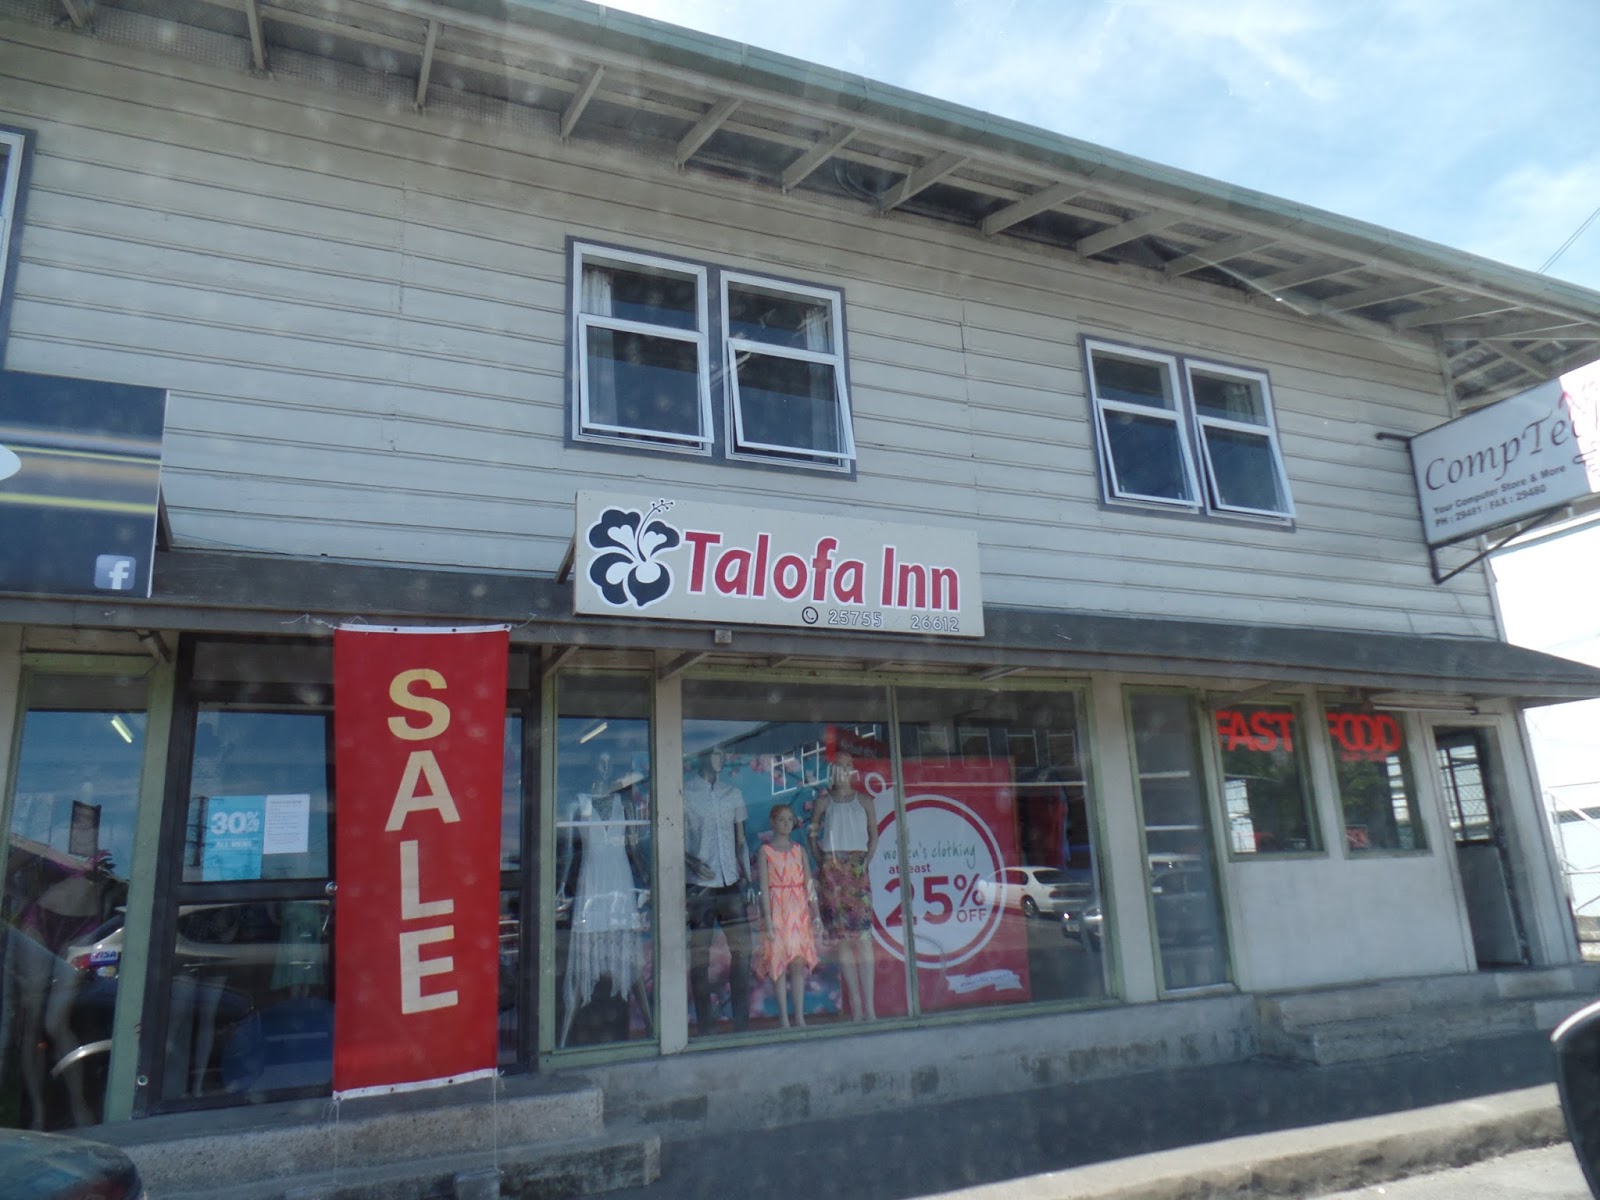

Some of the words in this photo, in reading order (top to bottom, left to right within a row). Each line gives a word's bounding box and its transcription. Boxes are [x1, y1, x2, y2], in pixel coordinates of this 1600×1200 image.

[1433, 504, 1453, 514] Your
[1455, 488, 1498, 507] Computer
[1501, 479, 1527, 492] Store
[1541, 466, 1565, 479] More
[1490, 498, 1508, 509] FAX
[685, 531, 864, 604] Talofa
[881, 547, 959, 611] Inn
[828, 609, 882, 627] 25755
[911, 614, 960, 632] 26612
[1216, 711, 1294, 751] FAST
[1326, 713, 1401, 752] FOOD
[384, 668, 461, 1014] SALE
[883, 842, 928, 861] woen's
[931, 839, 976, 870] clothing
[889, 865, 900, 874] at
[904, 863, 931, 874] east
[885, 873, 986, 927] 25%
[957, 908, 987, 923] OFF
